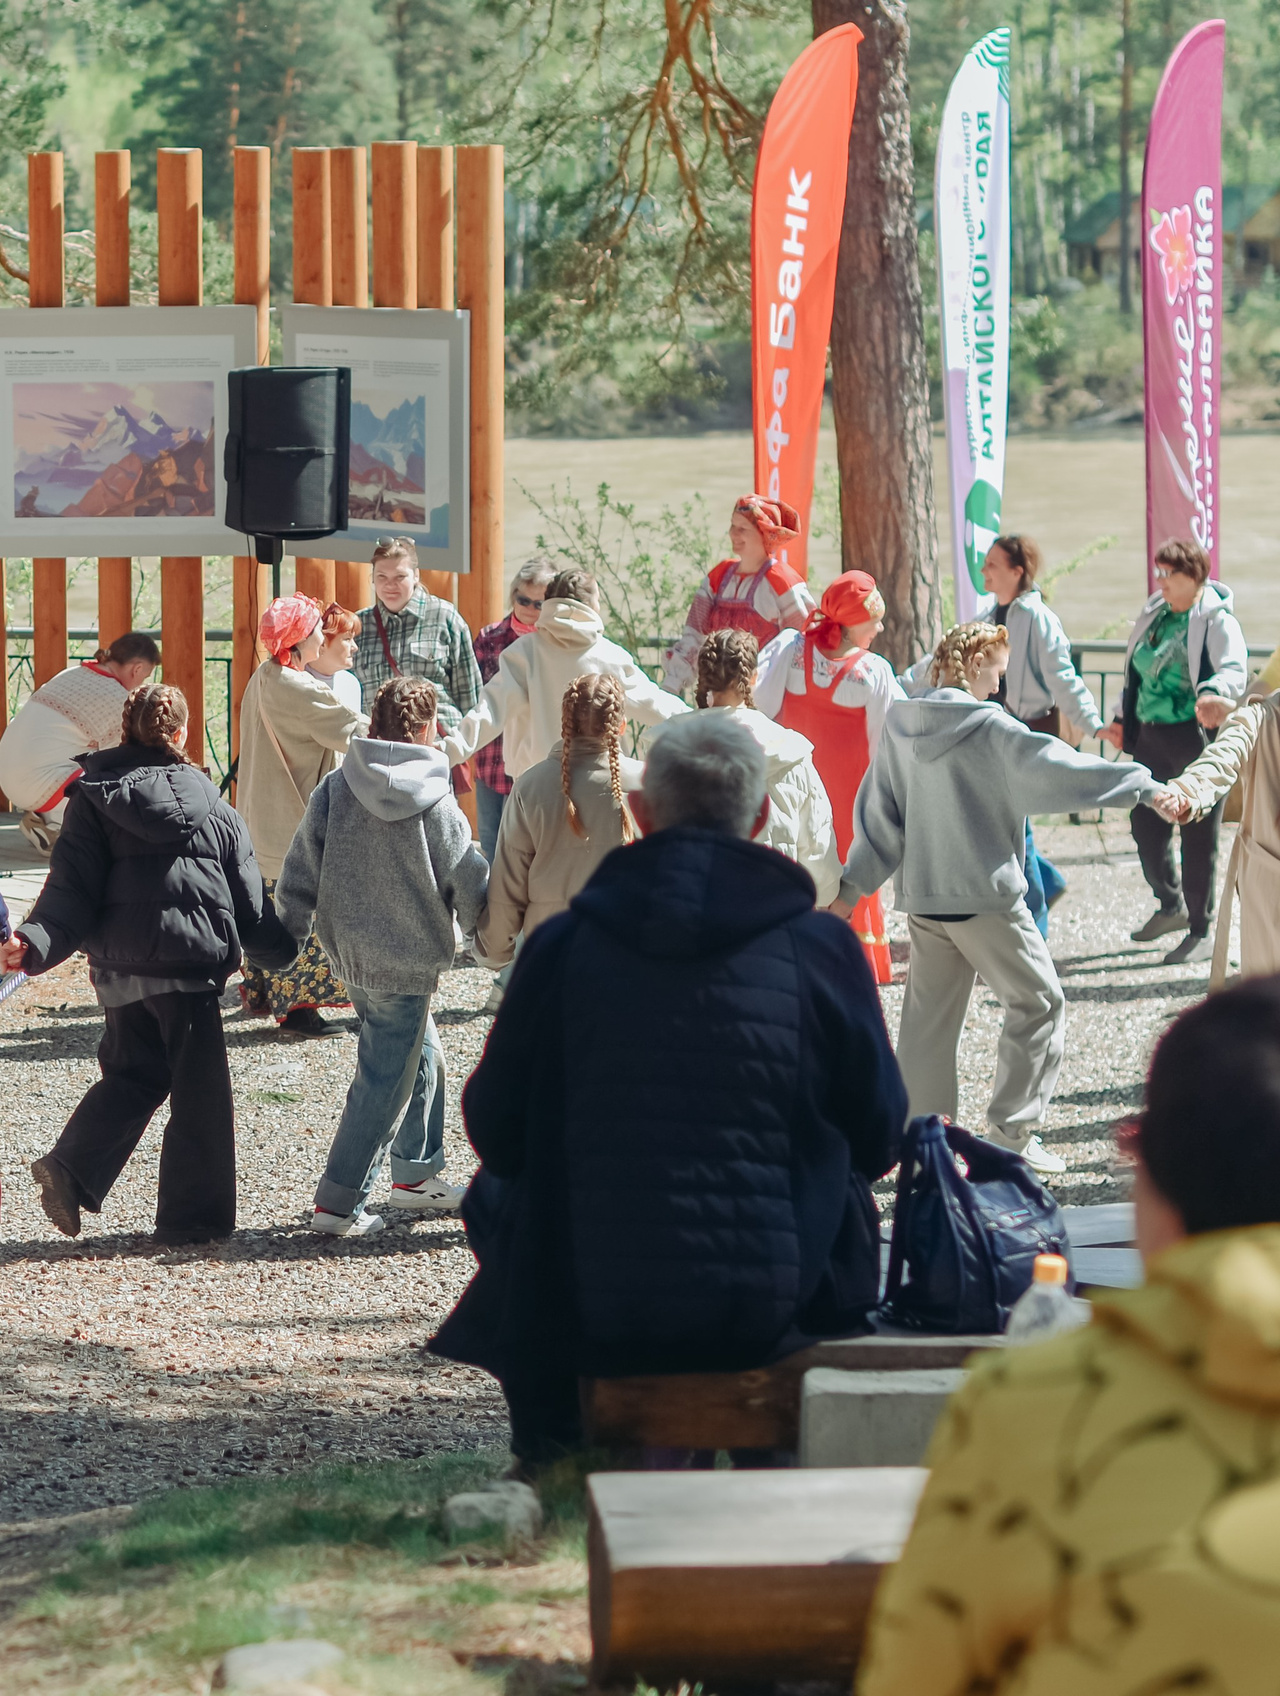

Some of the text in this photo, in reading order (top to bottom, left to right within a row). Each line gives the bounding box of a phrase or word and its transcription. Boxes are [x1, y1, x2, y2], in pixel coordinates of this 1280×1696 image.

[975, 111, 992, 204] РАЯ
[764, 167, 813, 564] ьфа Банк
